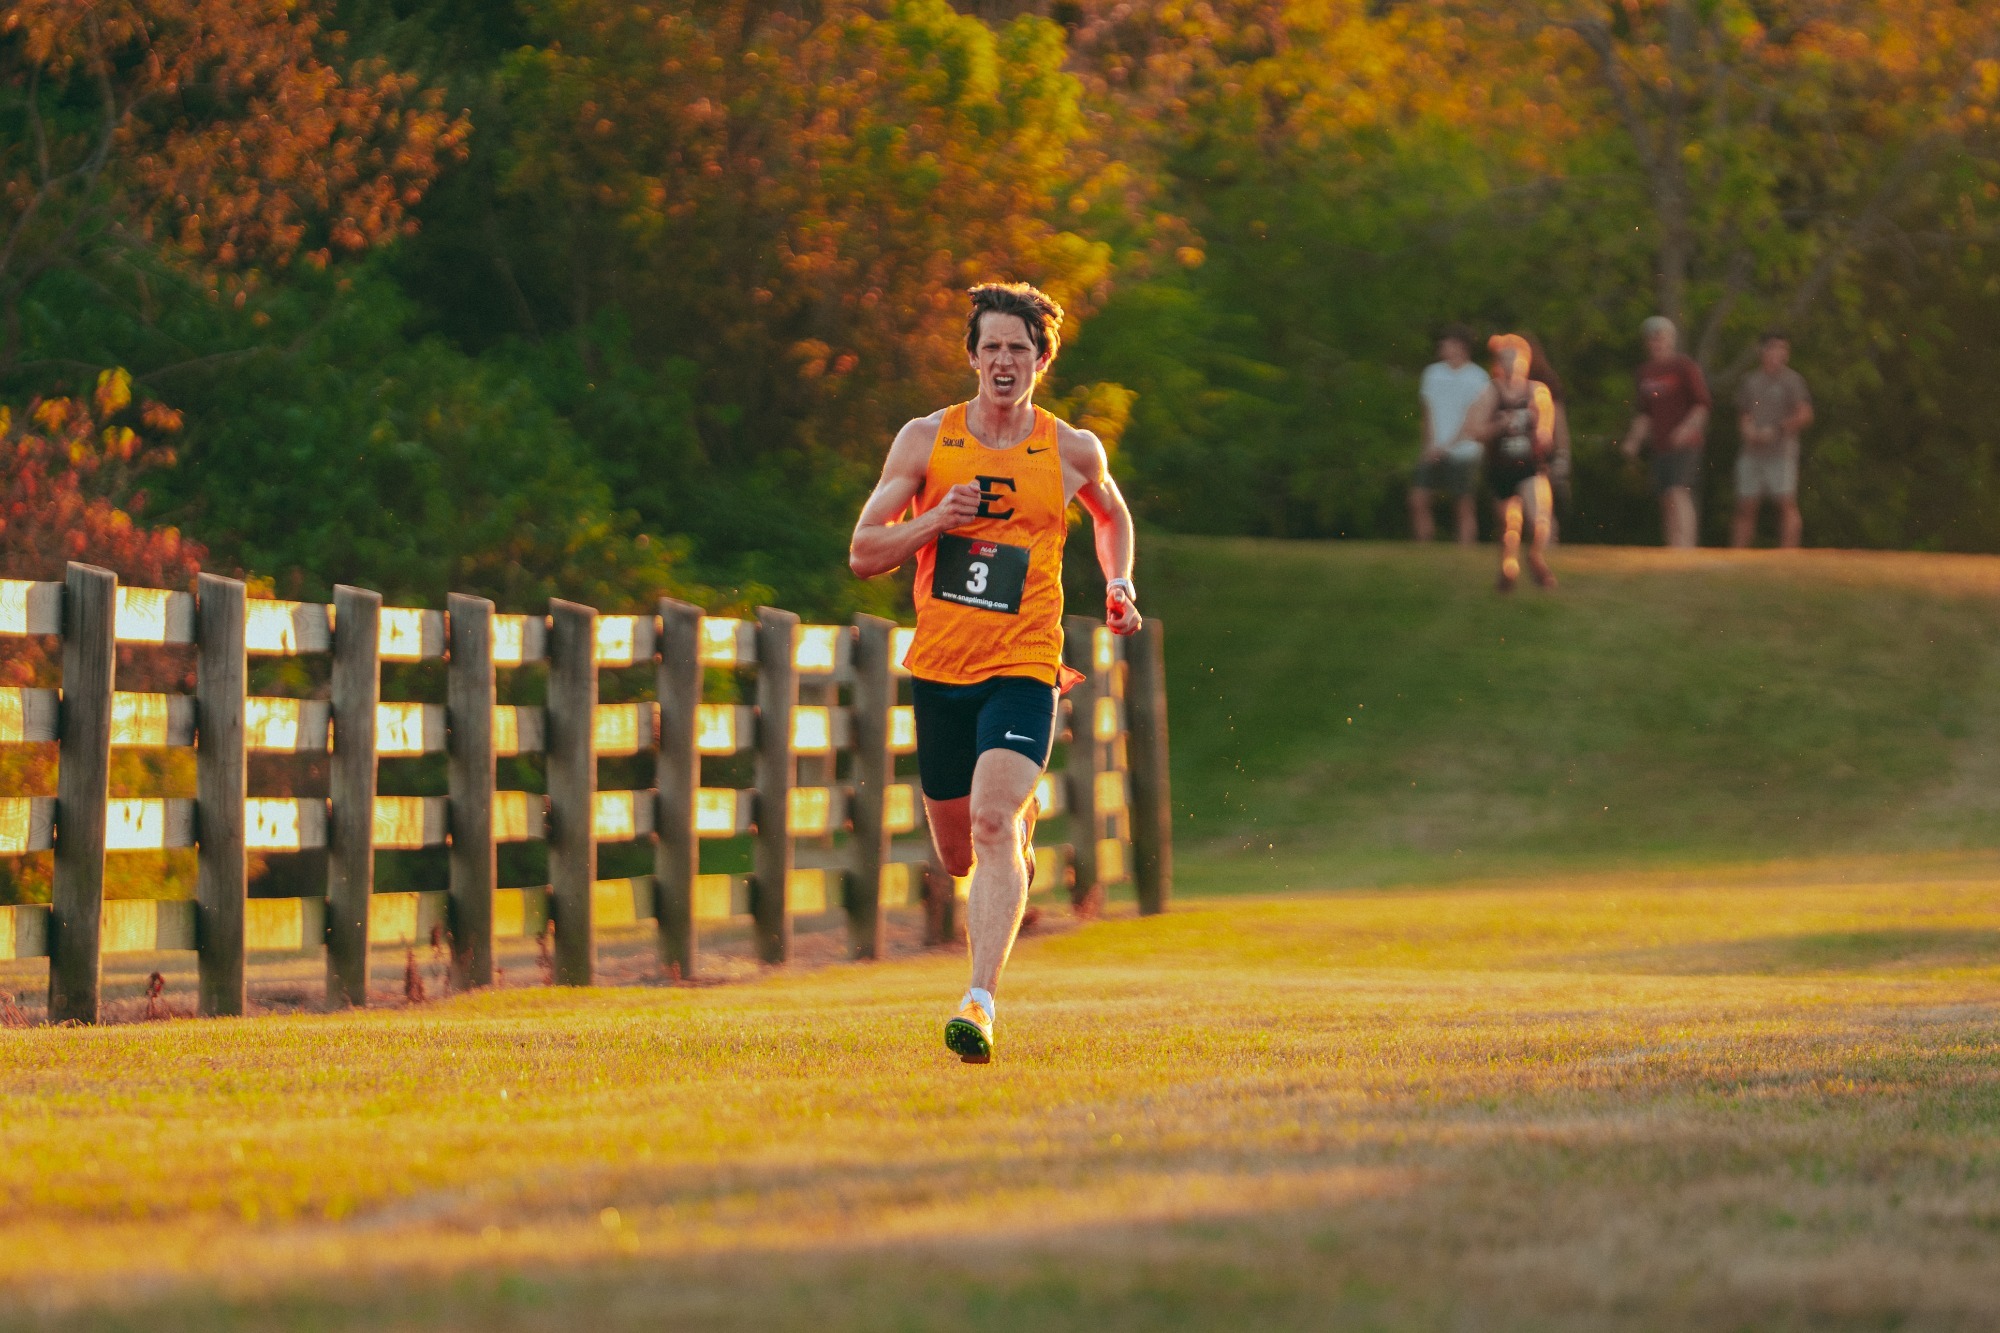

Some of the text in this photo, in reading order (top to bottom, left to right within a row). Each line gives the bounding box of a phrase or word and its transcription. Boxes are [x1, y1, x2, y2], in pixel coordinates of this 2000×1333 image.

[975, 475, 1016, 520] E
[966, 561, 989, 594] 3
[942, 591, 1008, 609] www.snaptiming.com
